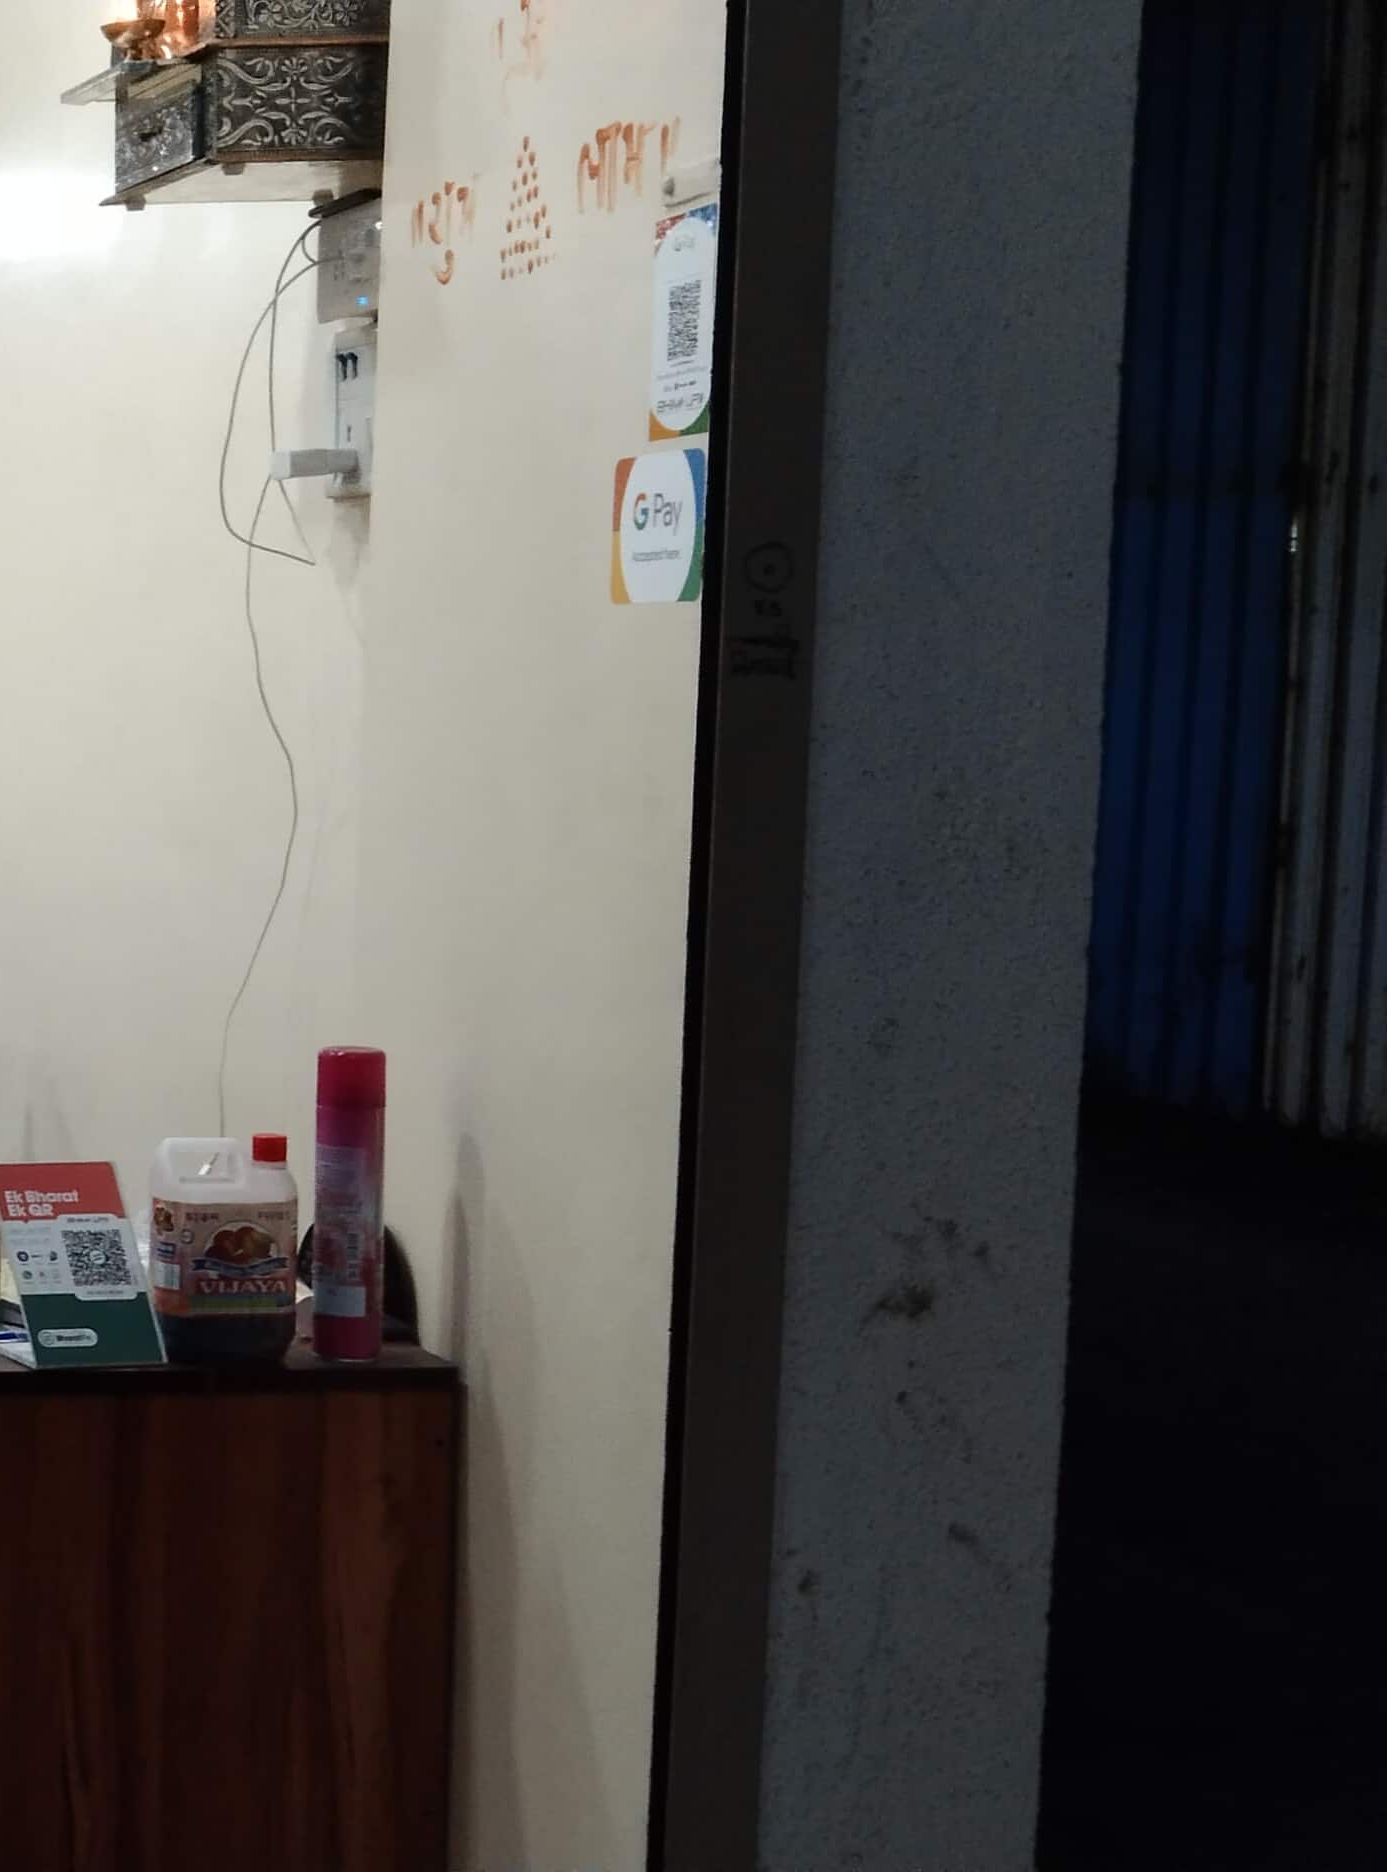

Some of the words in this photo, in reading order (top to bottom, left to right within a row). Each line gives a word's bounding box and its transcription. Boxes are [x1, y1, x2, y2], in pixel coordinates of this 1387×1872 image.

[651, 493, 683, 536] Pay
[4, 1191, 24, 1204] Ek
[26, 1190, 79, 1203] Bharat
[8, 1205, 27, 1217] Ek
[28, 1204, 54, 1217] QR
[199, 1280, 287, 1294] VIJAYA
